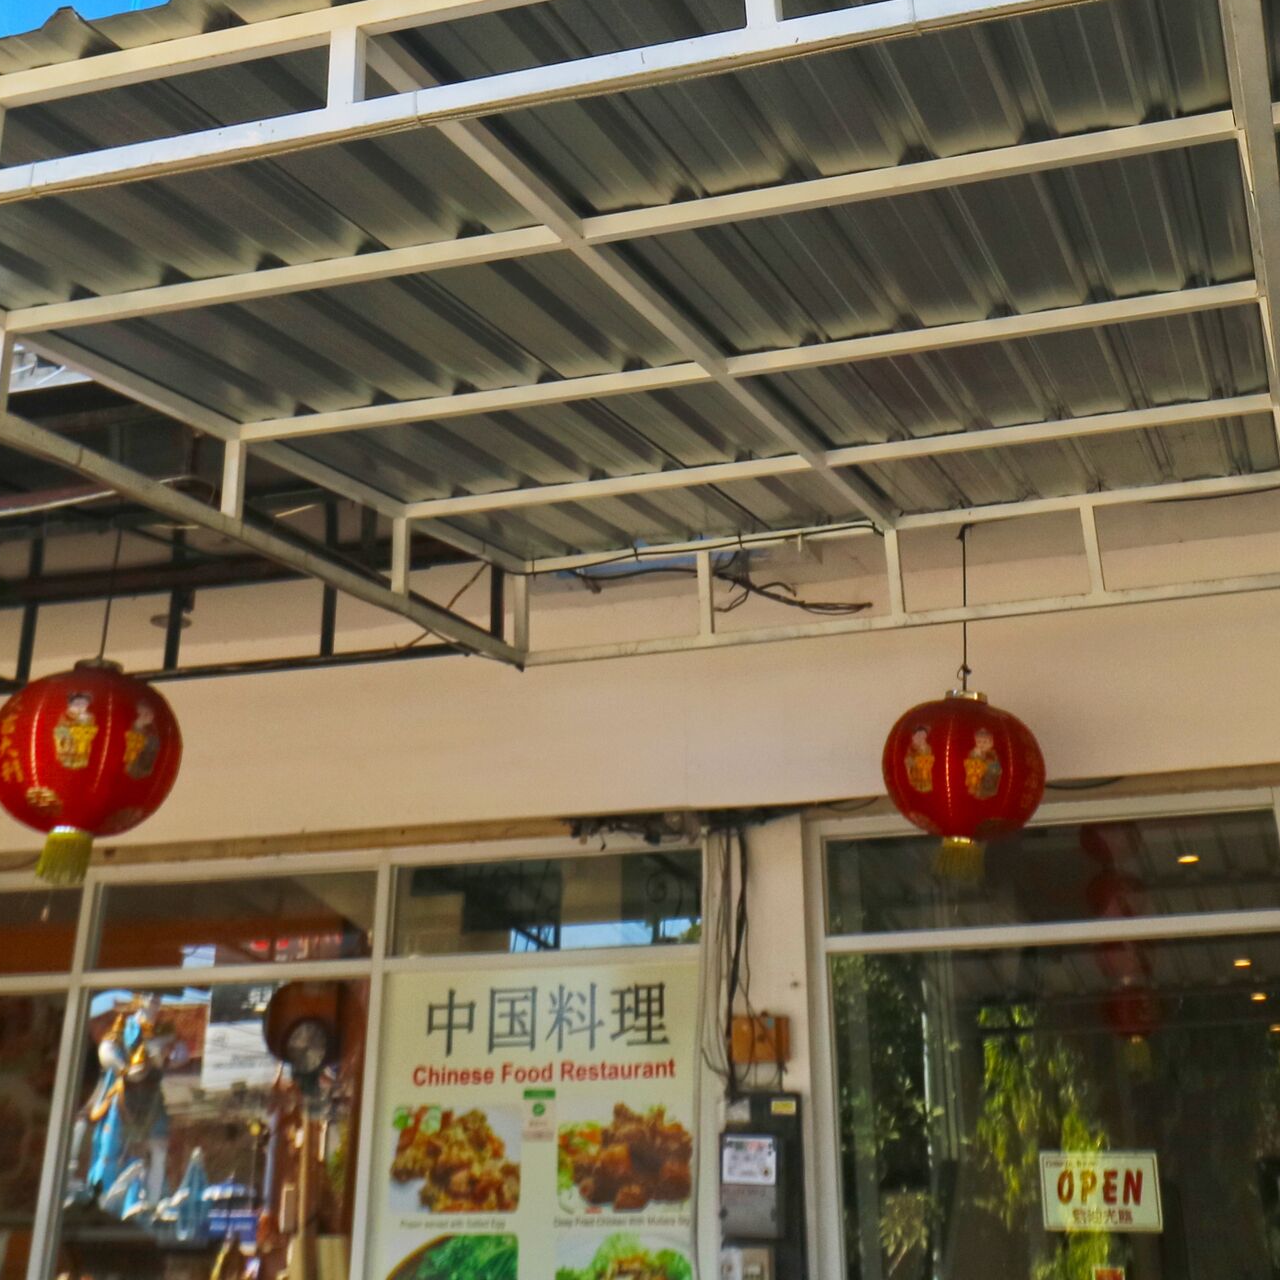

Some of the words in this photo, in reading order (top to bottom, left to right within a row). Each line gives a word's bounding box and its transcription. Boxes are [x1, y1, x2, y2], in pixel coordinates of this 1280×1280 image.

[426, 982, 669, 1057] 中国料理
[412, 1064, 494, 1086] Chinese
[501, 1061, 553, 1083] Food
[560, 1058, 676, 1081] Restaurant
[1057, 1169, 1143, 1206] OPEN
